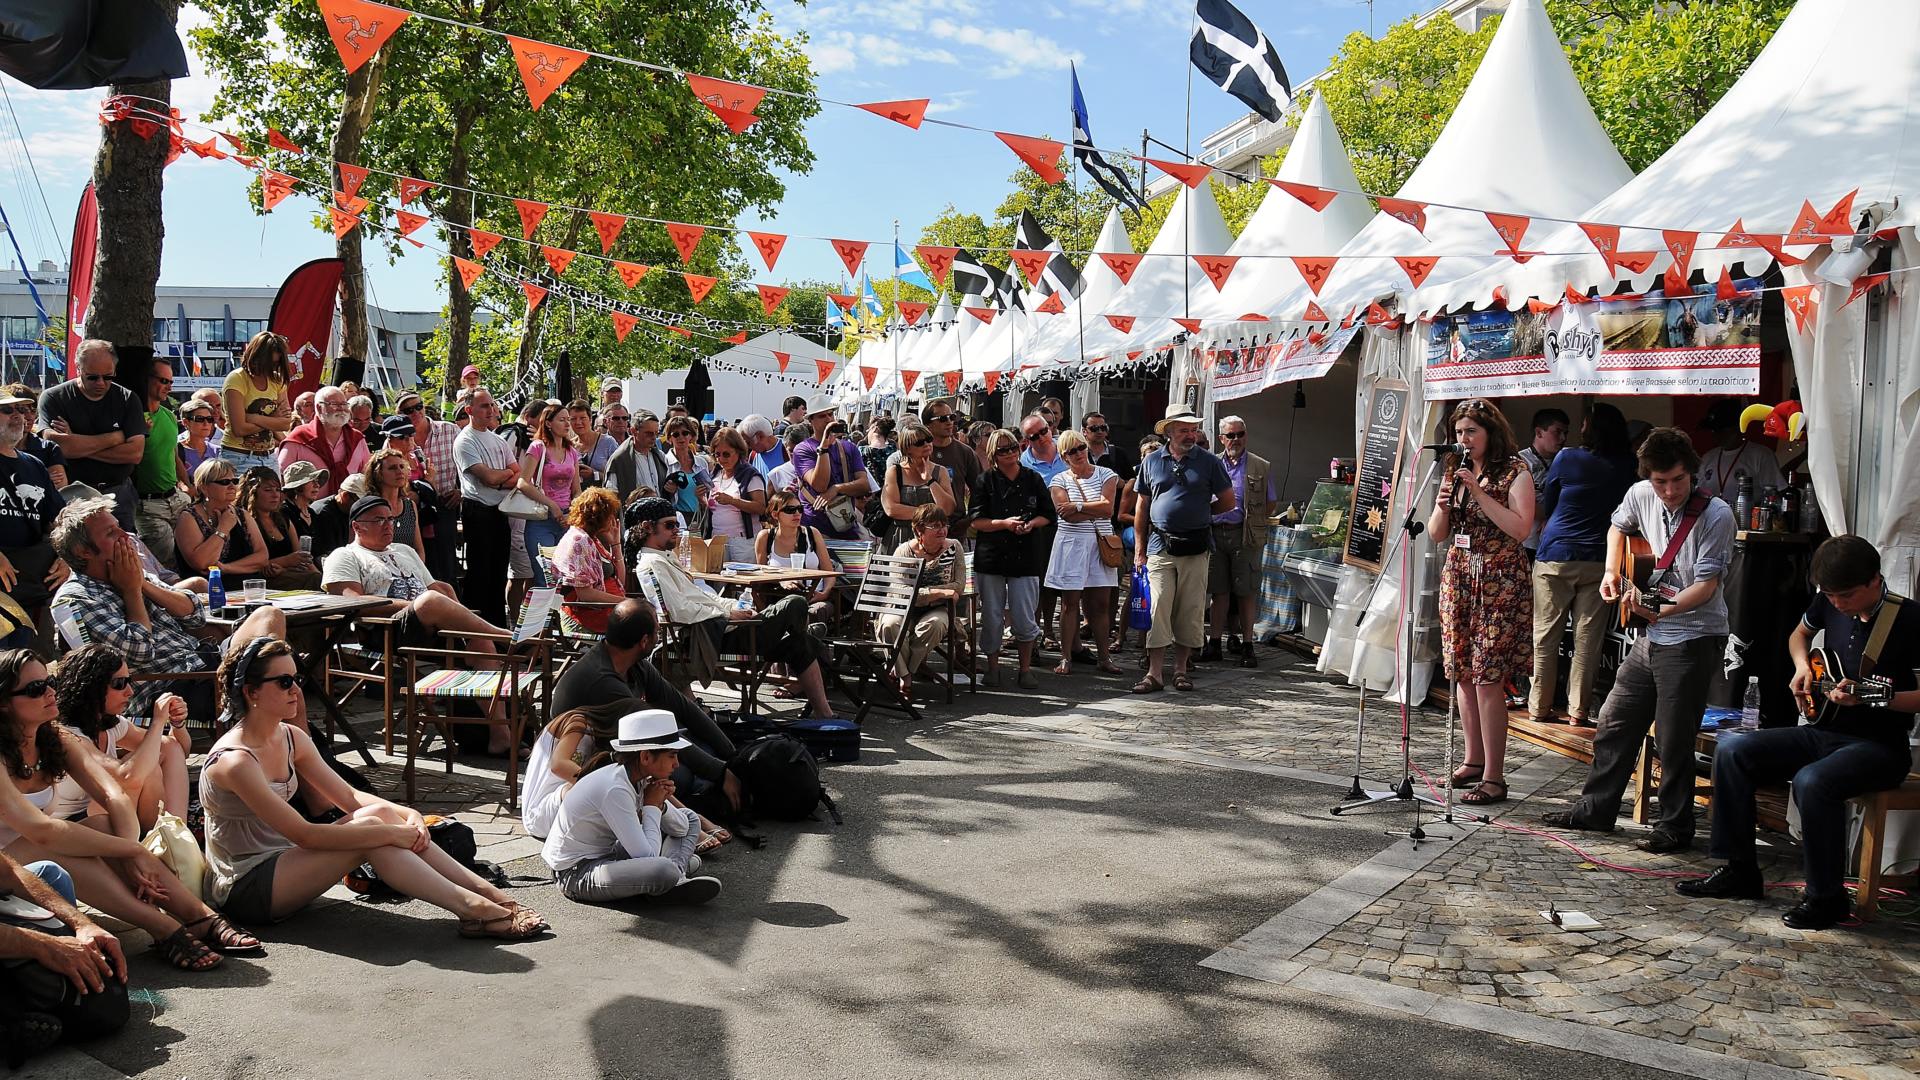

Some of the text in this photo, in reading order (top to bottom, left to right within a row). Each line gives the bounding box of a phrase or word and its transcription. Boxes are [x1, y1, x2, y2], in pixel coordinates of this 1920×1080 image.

[1486, 381, 1516, 391] tradition
[1578, 378, 1586, 386] la
[1587, 377, 1619, 386] tradition
[1625, 376, 1645, 386] Bière
[1645, 376, 1676, 386] Brassée
[1677, 376, 1699, 386] selon
[1699, 376, 1707, 386] la
[1708, 376, 1750, 386] tradition
